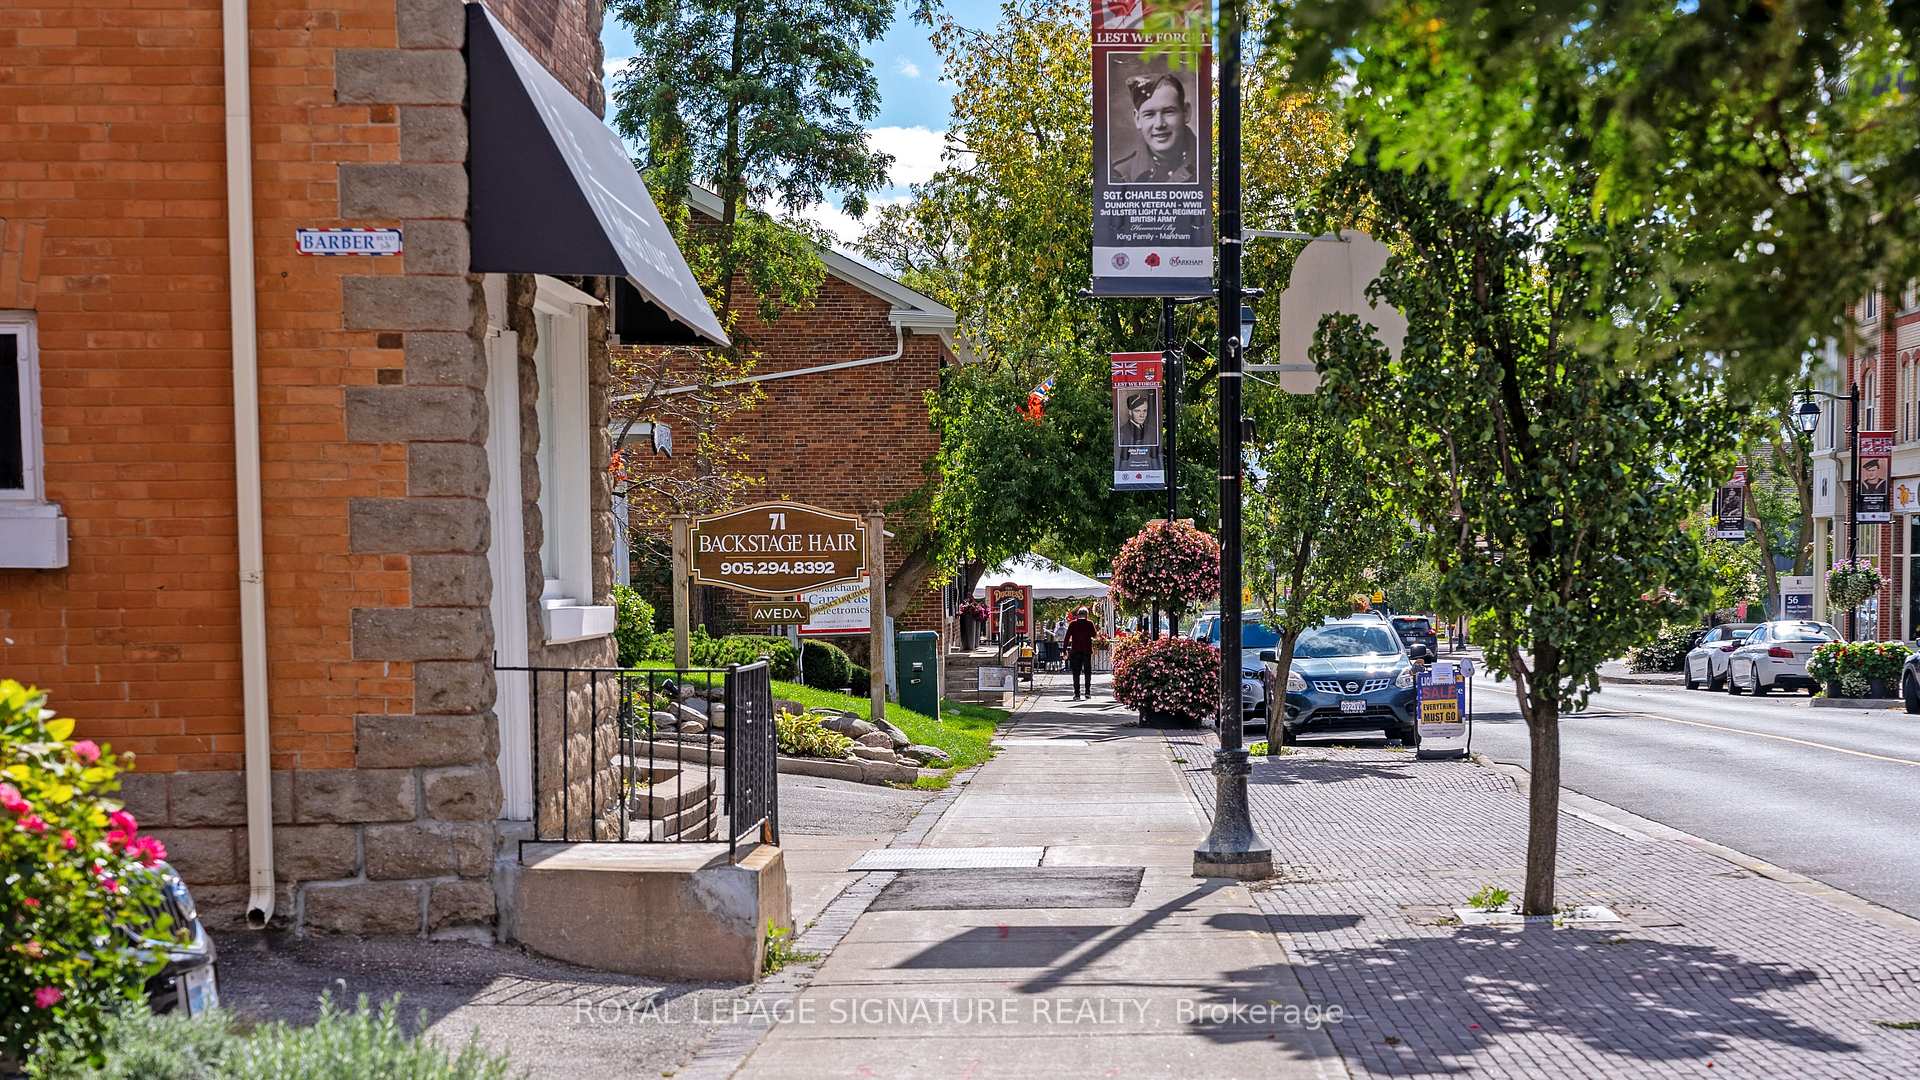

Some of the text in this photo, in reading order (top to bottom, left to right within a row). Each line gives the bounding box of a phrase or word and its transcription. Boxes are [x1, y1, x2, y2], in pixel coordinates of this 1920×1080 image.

[1097, 32, 1208, 43] LEST WE FORGT
[1103, 191, 1204, 200] SGT. CHARLES DOWDS
[303, 235, 375, 249] BARBER
[1117, 233, 1132, 241] King
[1132, 233, 1154, 241] Family
[768, 513, 786, 531] 71
[699, 533, 857, 553] BACKSTAGE HAIR
[720, 561, 836, 575] 905.294.8392
[1787, 596, 1799, 604] 56
[753, 608, 803, 619] AVEDA
[1421, 687, 1457, 700] SALE
[1423, 702, 1456, 711] EVERYTHING
[1423, 712, 1456, 722] MUST GO
